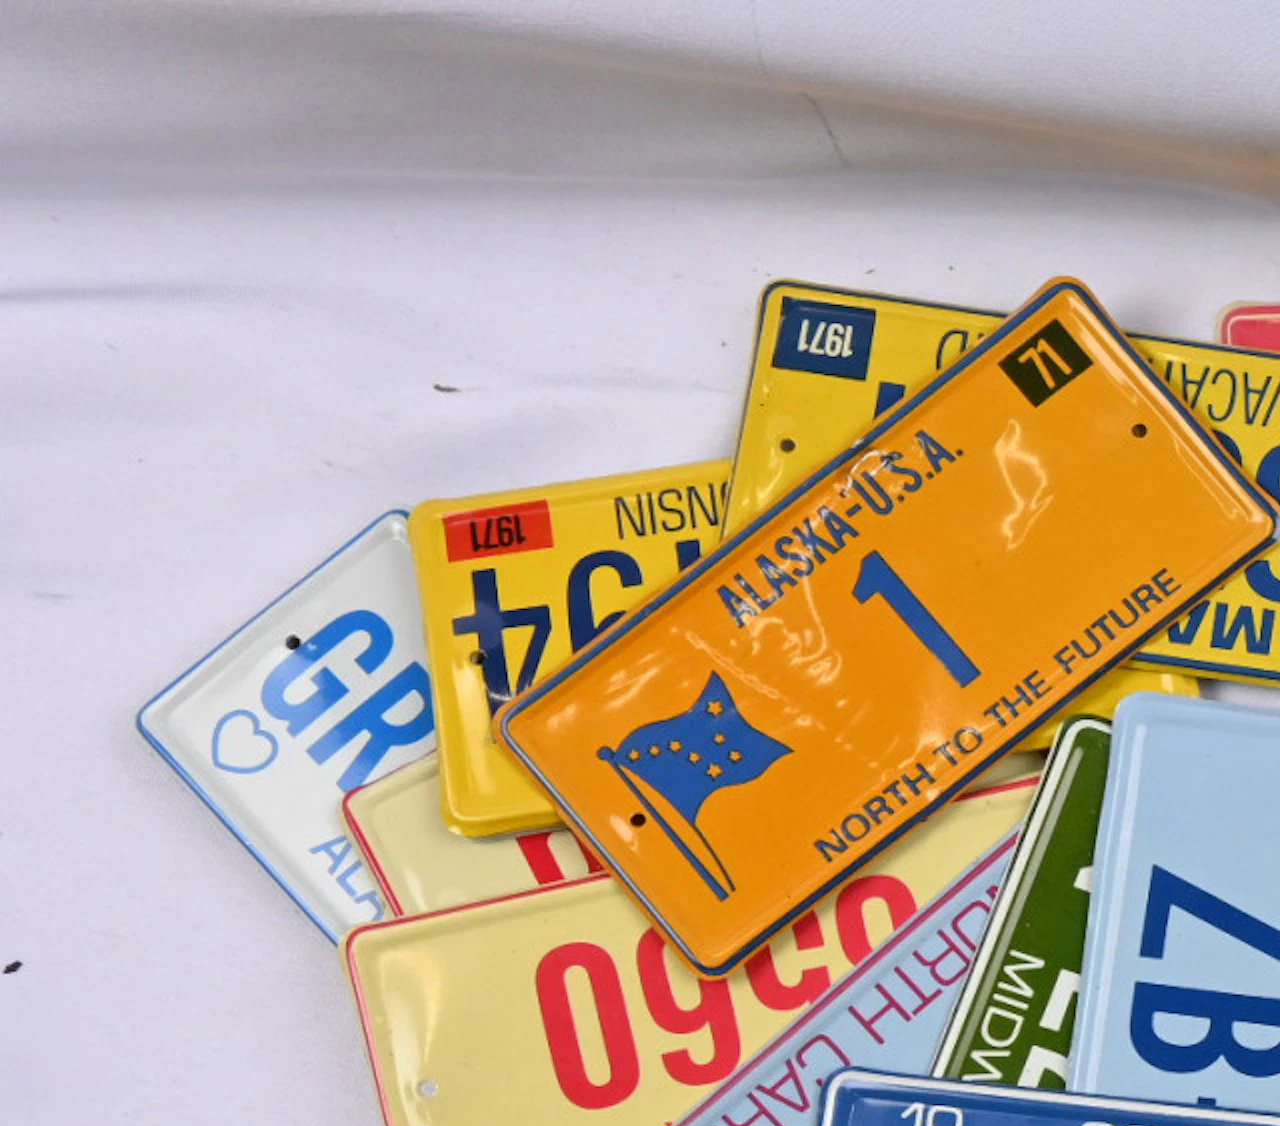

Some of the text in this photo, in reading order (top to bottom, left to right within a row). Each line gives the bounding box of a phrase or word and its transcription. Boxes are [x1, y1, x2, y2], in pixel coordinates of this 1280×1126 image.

[797, 317, 853, 358] 1971
[1017, 337, 1070, 389] 71
[469, 516, 526, 550] 1971
[612, 480, 728, 539] NSIN
[851, 550, 981, 688] 1
[812, 567, 1181, 862] NORTH TO THE FUTURE
[850, 884, 1006, 1044] ORTH
